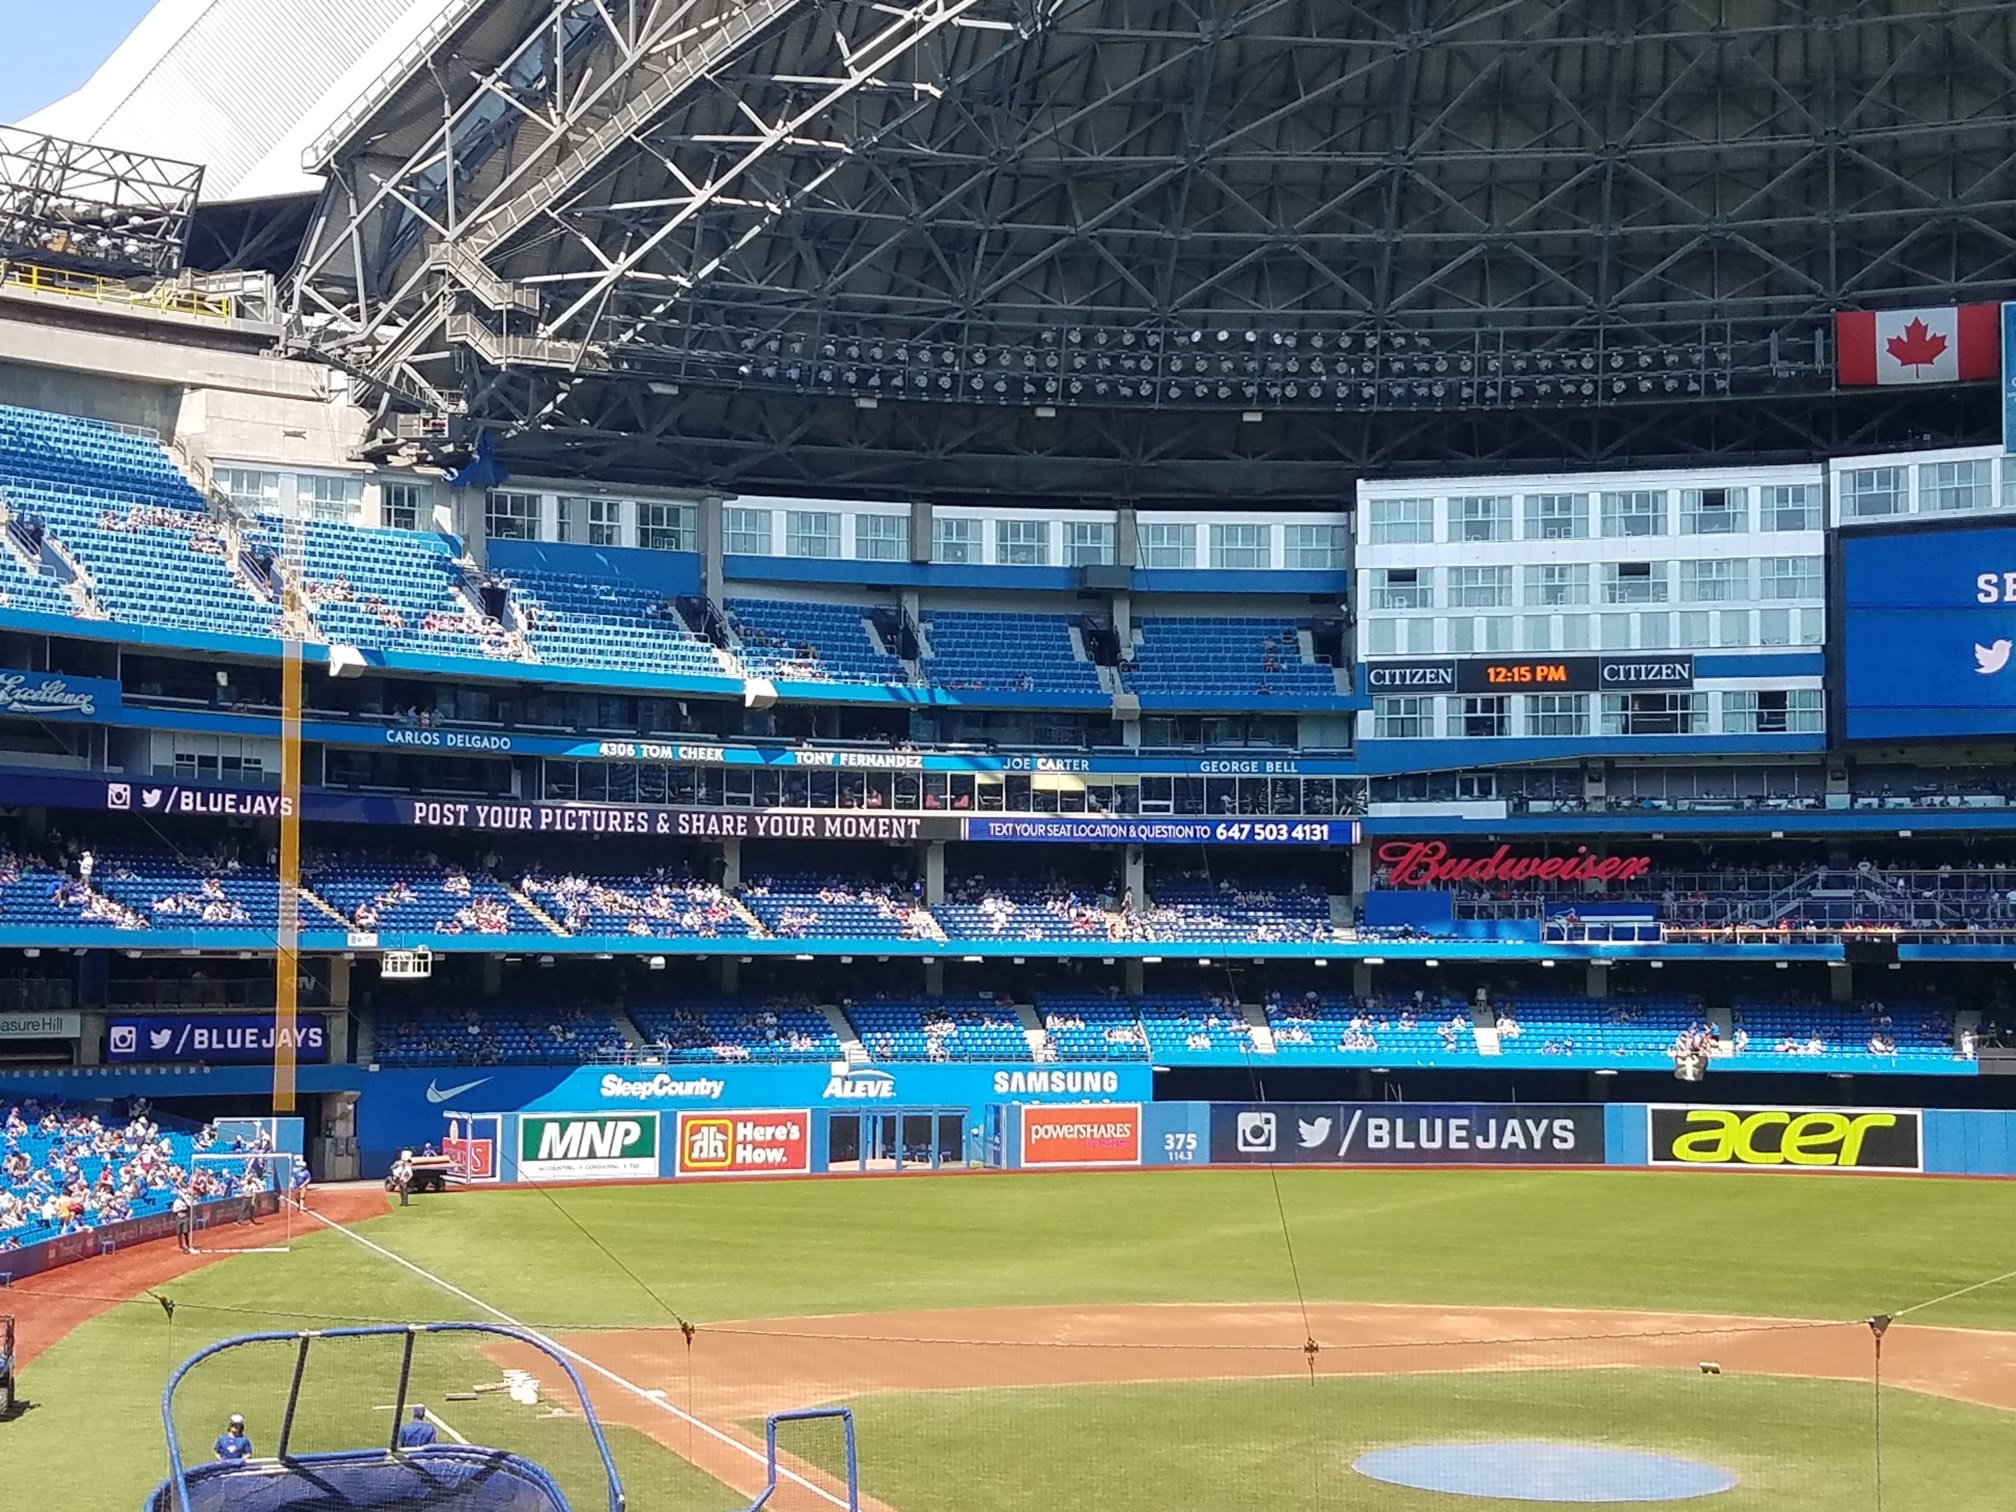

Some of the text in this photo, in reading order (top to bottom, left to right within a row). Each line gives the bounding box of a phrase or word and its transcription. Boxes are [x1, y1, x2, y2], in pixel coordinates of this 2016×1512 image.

[1369, 668, 1453, 685] CITIZEN
[1487, 665, 1567, 682] 12:15 PM
[1603, 663, 1690, 681] CITIZEN
[0, 673, 95, 715] Excellence
[386, 729, 511, 749] CARLOS DELGADO
[599, 742, 724, 762] 4306 TOM CHEEK
[795, 751, 923, 768] TONY FERNANDEZ
[1003, 758, 1089, 771] JOE CARTER
[1200, 760, 1298, 773] GEORGE BELL
[414, 802, 921, 838] POST YOUR PICTURES & SHARE YOUR MOMENT
[989, 823, 1328, 841] TEXT YOUR SEAT LOCATION & QUESTION TO 647 503 4131
[1378, 840, 1650, 885] Budweiser
[42, 1017, 63, 1031] Hill
[994, 1070, 1118, 1093] SAMSUNG
[537, 1120, 641, 1160] MNP
[736, 1120, 800, 1141] Here's
[1671, 1110, 1897, 1166] acer
[1164, 1133, 1198, 1151] 375
[736, 1143, 788, 1164] How.
[1168, 1151, 1193, 1161] 114.3
